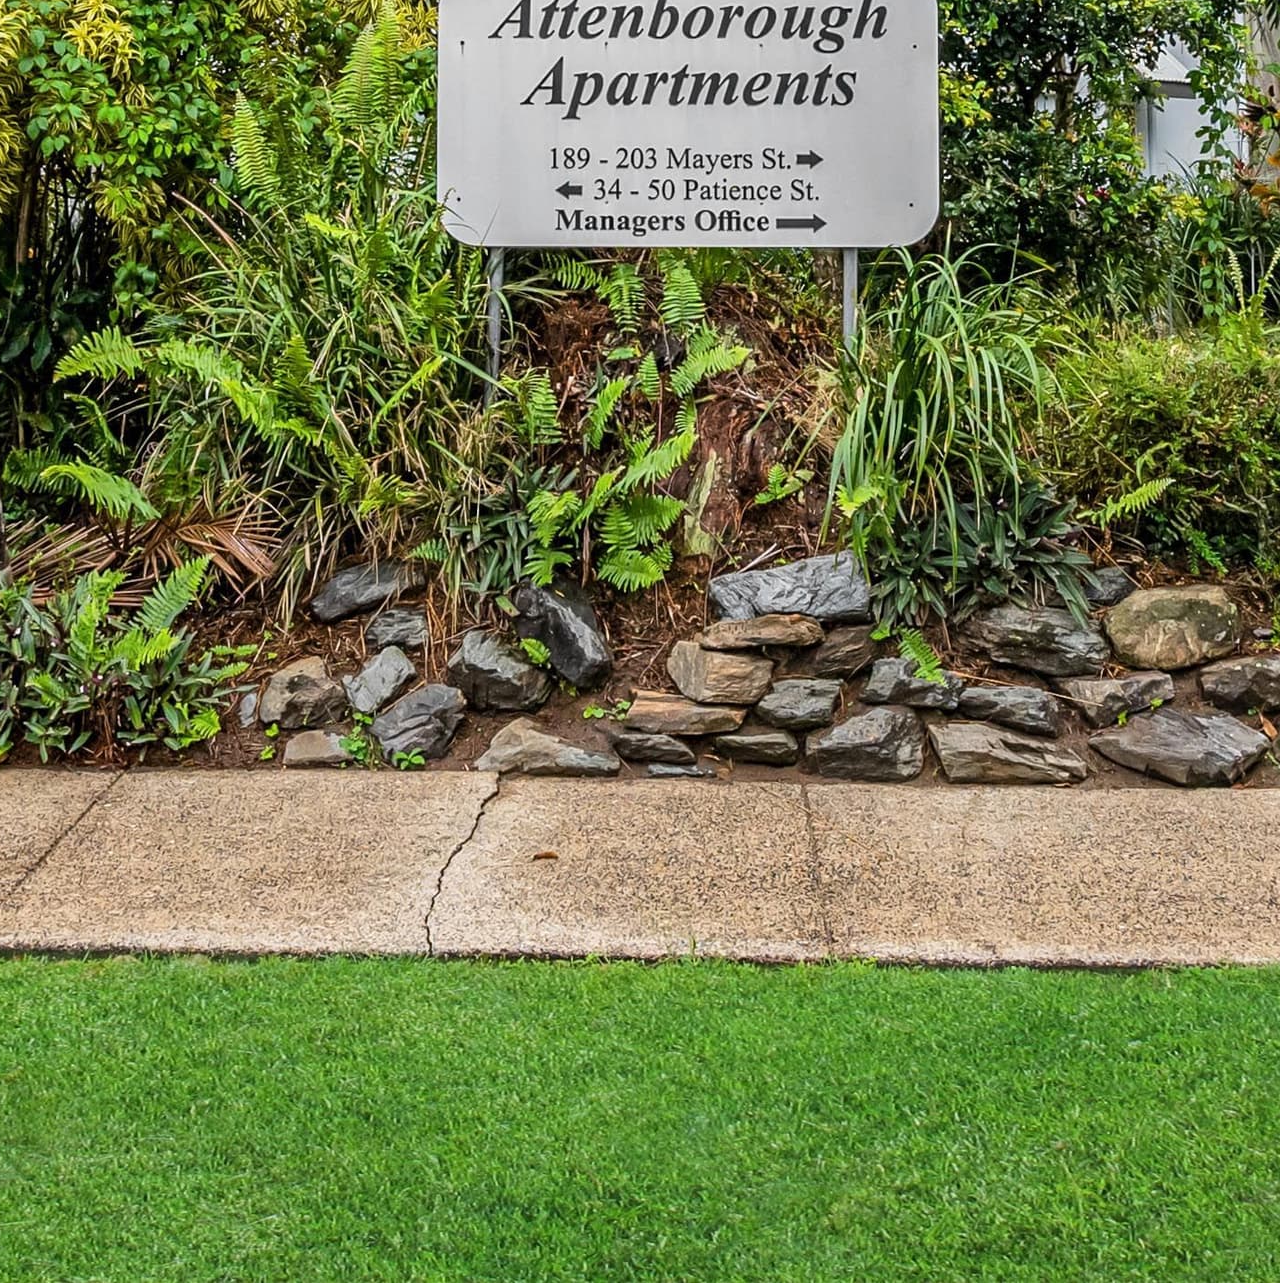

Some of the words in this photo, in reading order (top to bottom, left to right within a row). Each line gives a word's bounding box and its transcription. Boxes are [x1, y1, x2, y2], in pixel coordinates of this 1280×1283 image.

[520, 56, 858, 121] Apartments
[549, 147, 591, 170] 189
[615, 147, 657, 170] 203
[666, 147, 754, 175] Mayers
[762, 147, 792, 170] St.
[593, 178, 623, 201] 34
[647, 178, 676, 201] 50
[683, 178, 782, 201] Patience
[790, 178, 820, 202] St.
[554, 208, 686, 237] Managers
[694, 209, 770, 232] Office
